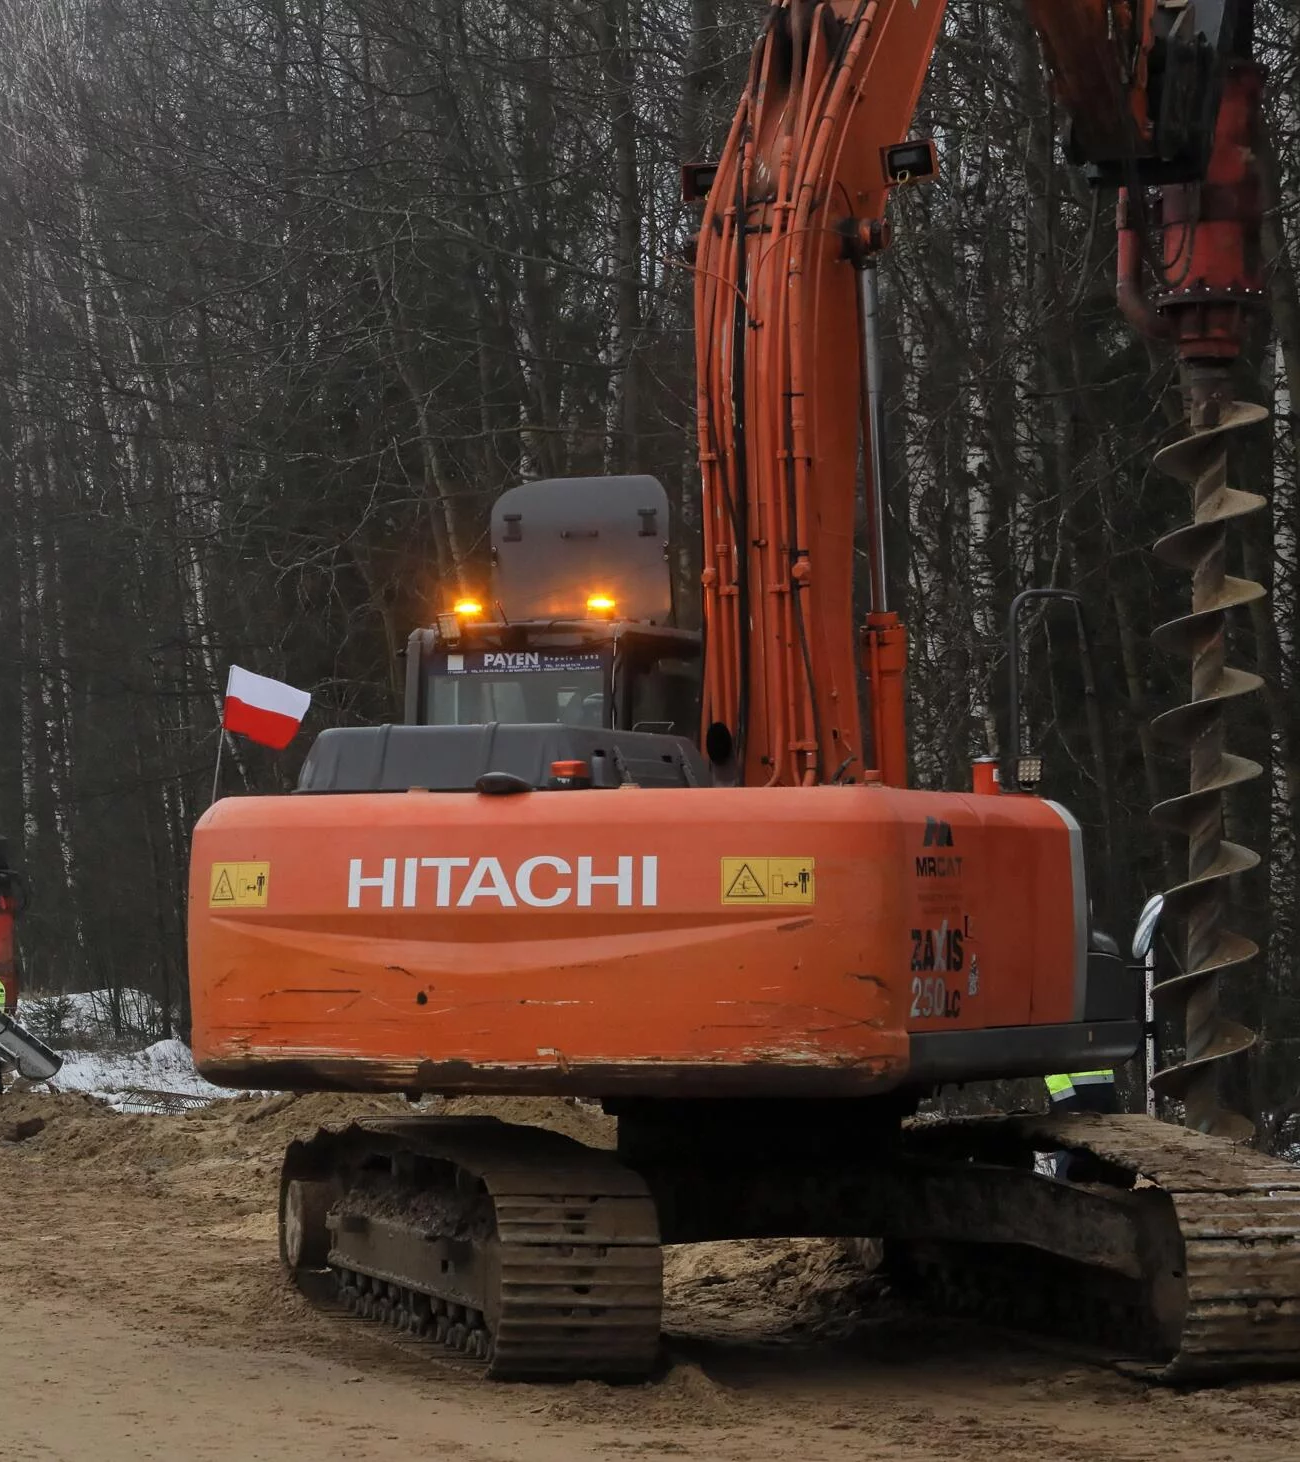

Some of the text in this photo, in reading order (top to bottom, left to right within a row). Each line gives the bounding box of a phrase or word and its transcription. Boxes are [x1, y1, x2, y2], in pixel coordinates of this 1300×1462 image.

[483, 652, 539, 667] PAYEN
[347, 855, 658, 907] HITACHI
[915, 856, 963, 878] MRCAT
[910, 919, 964, 972] ZAXIS
